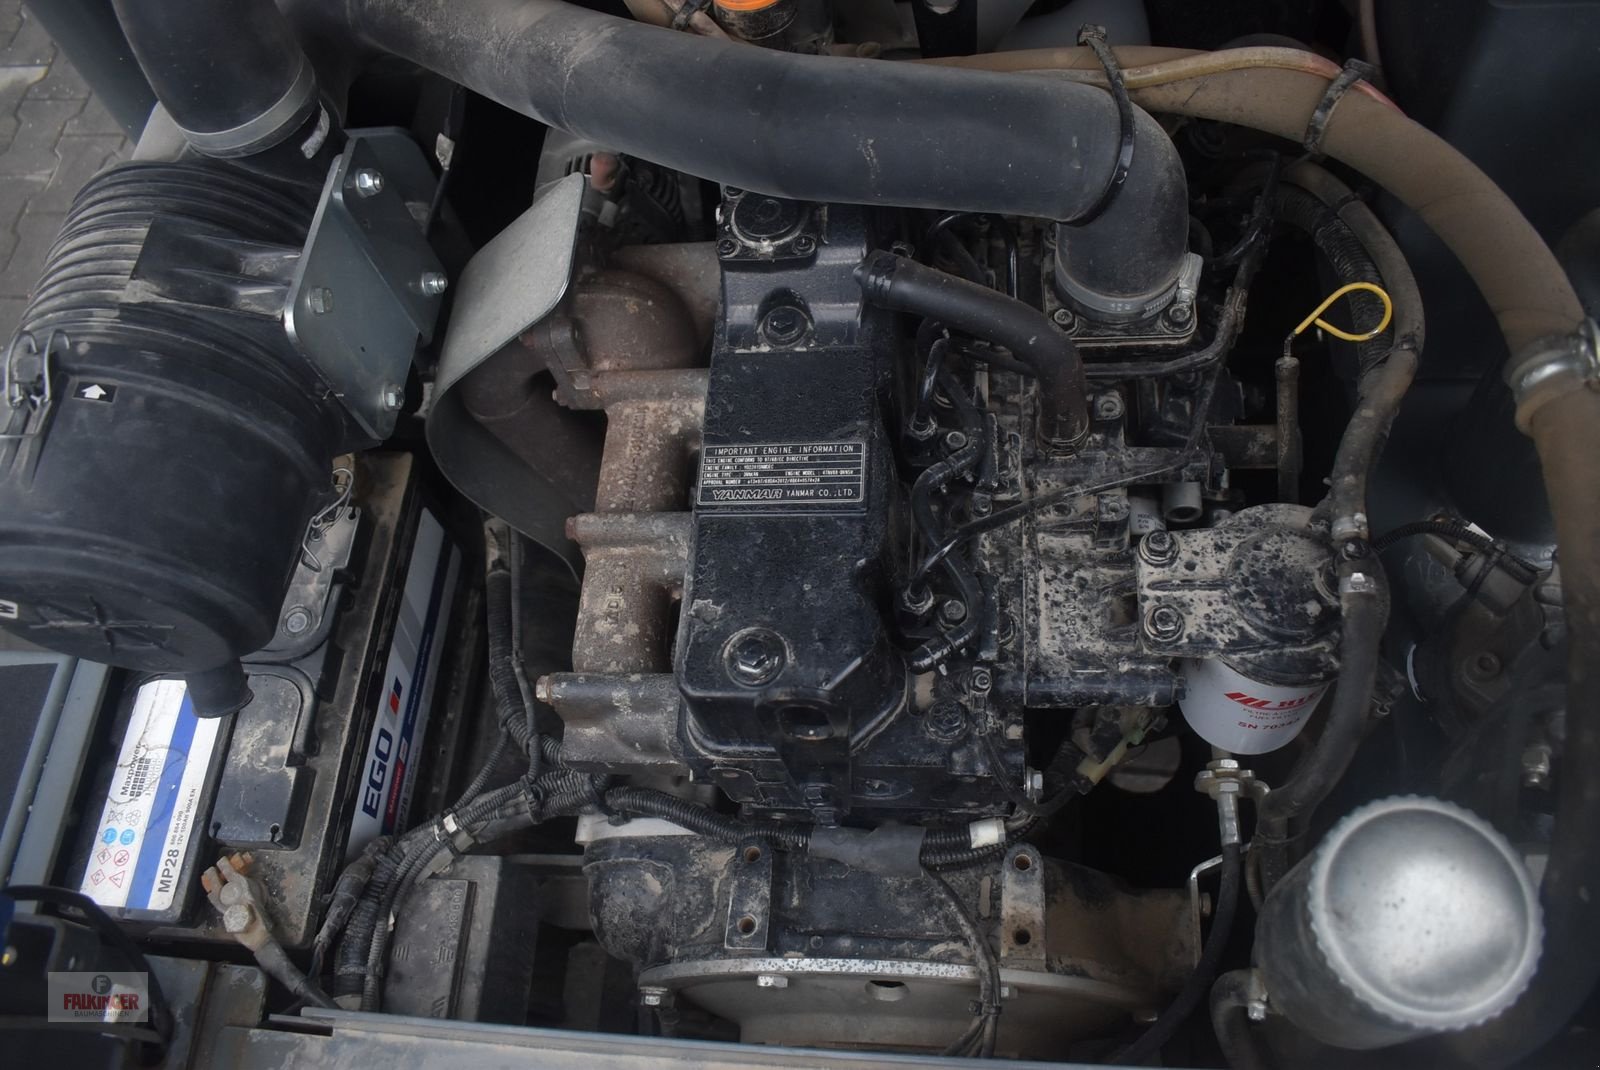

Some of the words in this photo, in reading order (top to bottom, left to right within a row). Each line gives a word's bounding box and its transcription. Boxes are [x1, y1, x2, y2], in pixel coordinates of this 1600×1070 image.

[714, 447, 758, 456] IMPORTANT
[763, 446, 793, 455] ENGINE
[800, 444, 854, 454] INFORMATION
[712, 488, 783, 500] YANMAR
[786, 488, 815, 497] YANMAR
[1237, 721, 1259, 730] SN
[120, 743, 142, 796] Maxpower
[362, 727, 393, 819] EGO
[158, 849, 179, 893] MP28
